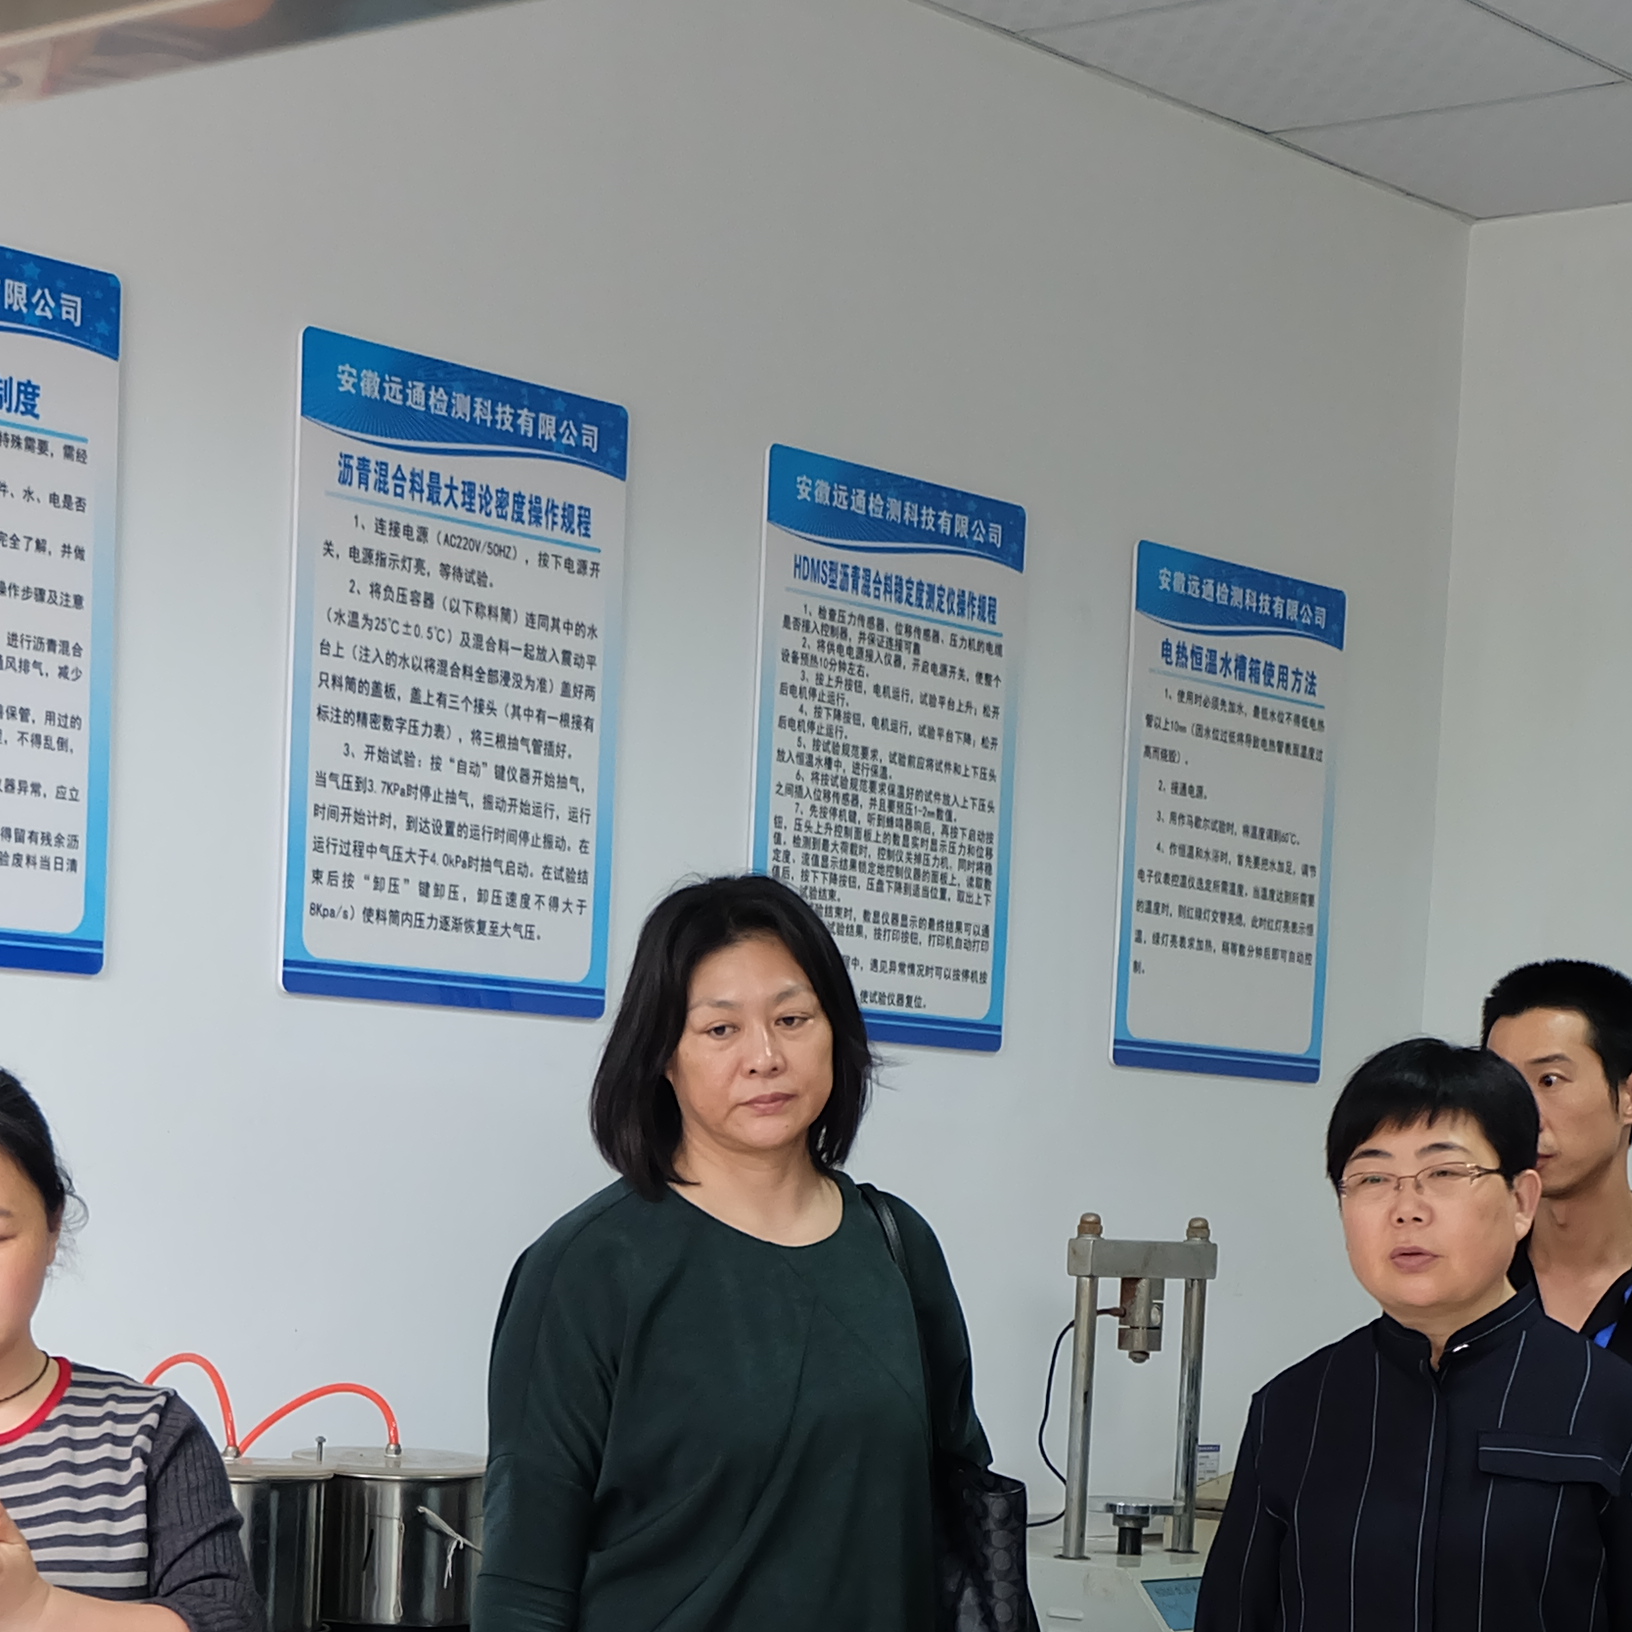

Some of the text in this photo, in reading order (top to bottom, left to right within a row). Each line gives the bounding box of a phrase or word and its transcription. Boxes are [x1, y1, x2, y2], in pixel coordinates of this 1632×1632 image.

[336, 363, 600, 454] 安徽远通检测科技有限公司
[337, 451, 592, 540] 沥青混合料最大理论密度操作规程
[795, 474, 1003, 549] 安徽远通检测科技有限公司
[1158, 567, 1327, 630] 安徽远通检测科技有限公司
[1161, 637, 1318, 698] 电热恒温水槽箱使用方法
